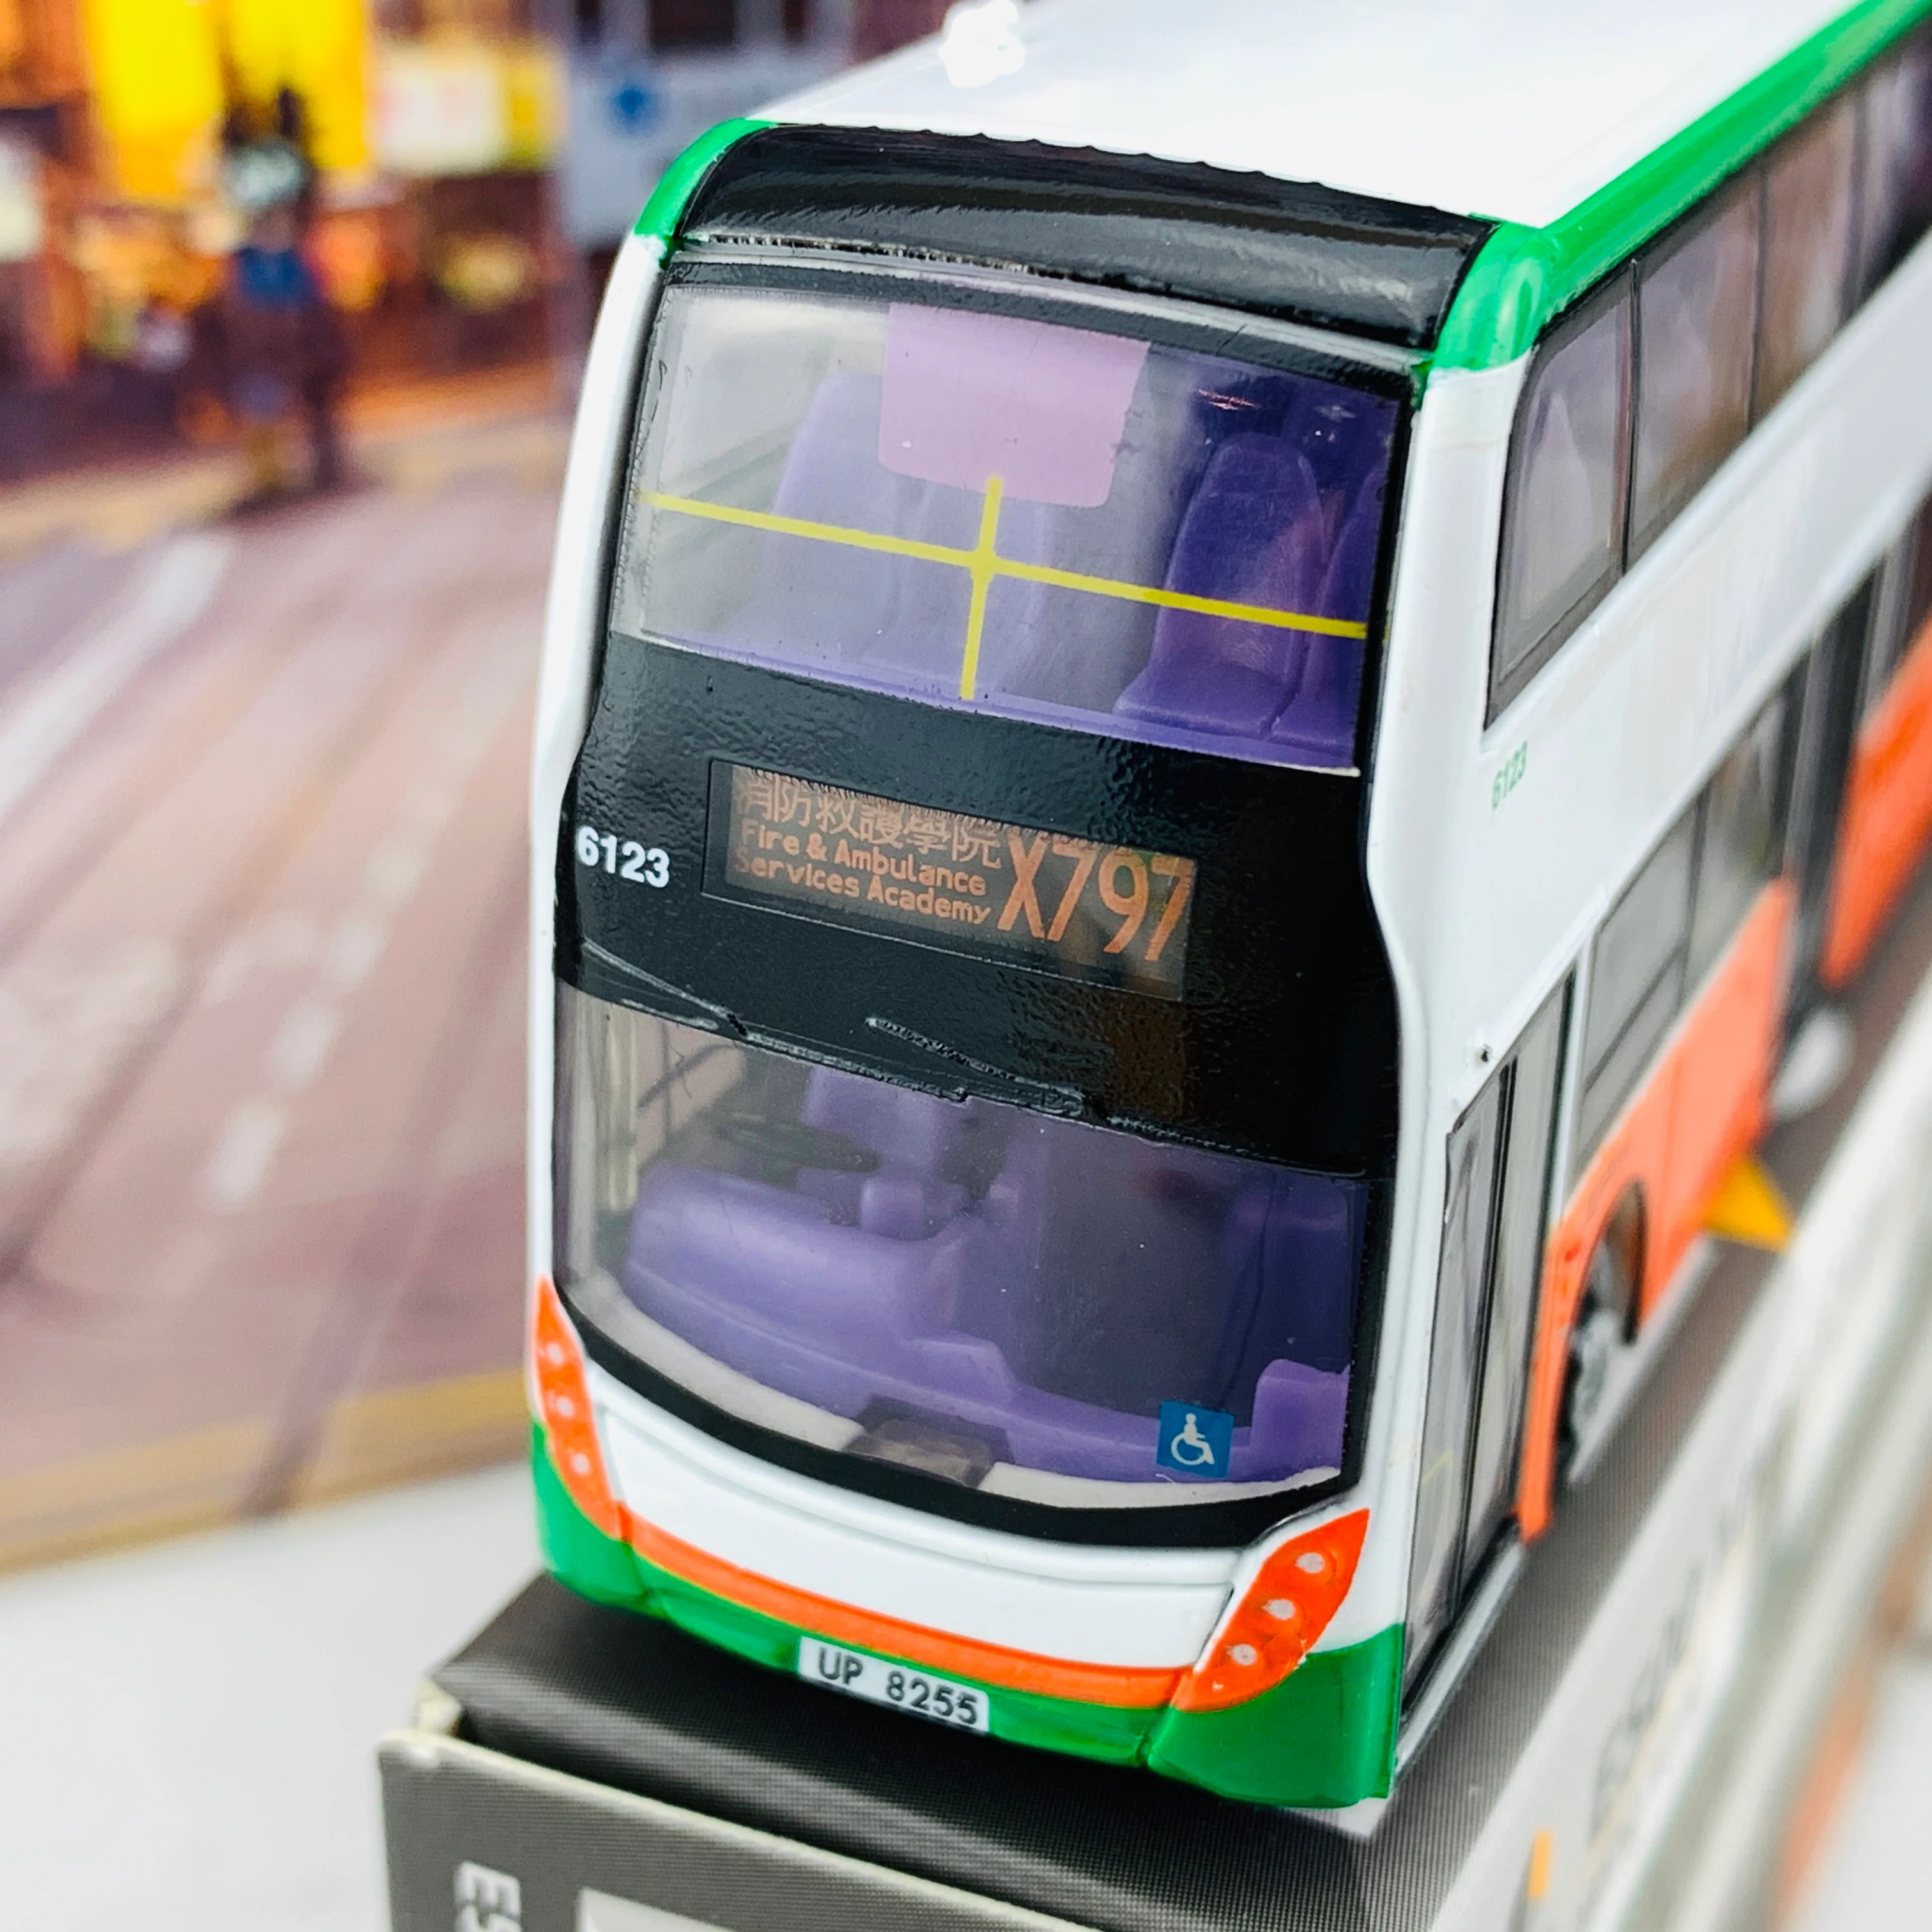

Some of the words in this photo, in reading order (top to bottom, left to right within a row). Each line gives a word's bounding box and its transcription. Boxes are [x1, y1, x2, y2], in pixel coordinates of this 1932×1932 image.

[1492, 740, 1528, 810] 6123
[578, 825, 670, 888] 6123
[736, 846, 861, 898] Services
[866, 875, 992, 926] Academy
[741, 818, 800, 857] Fire
[805, 832, 829, 862] &
[833, 838, 987, 896] Ambulance
[997, 827, 1195, 962] X797
[818, 1646, 864, 1685] UP
[885, 1671, 978, 1726] 8255
